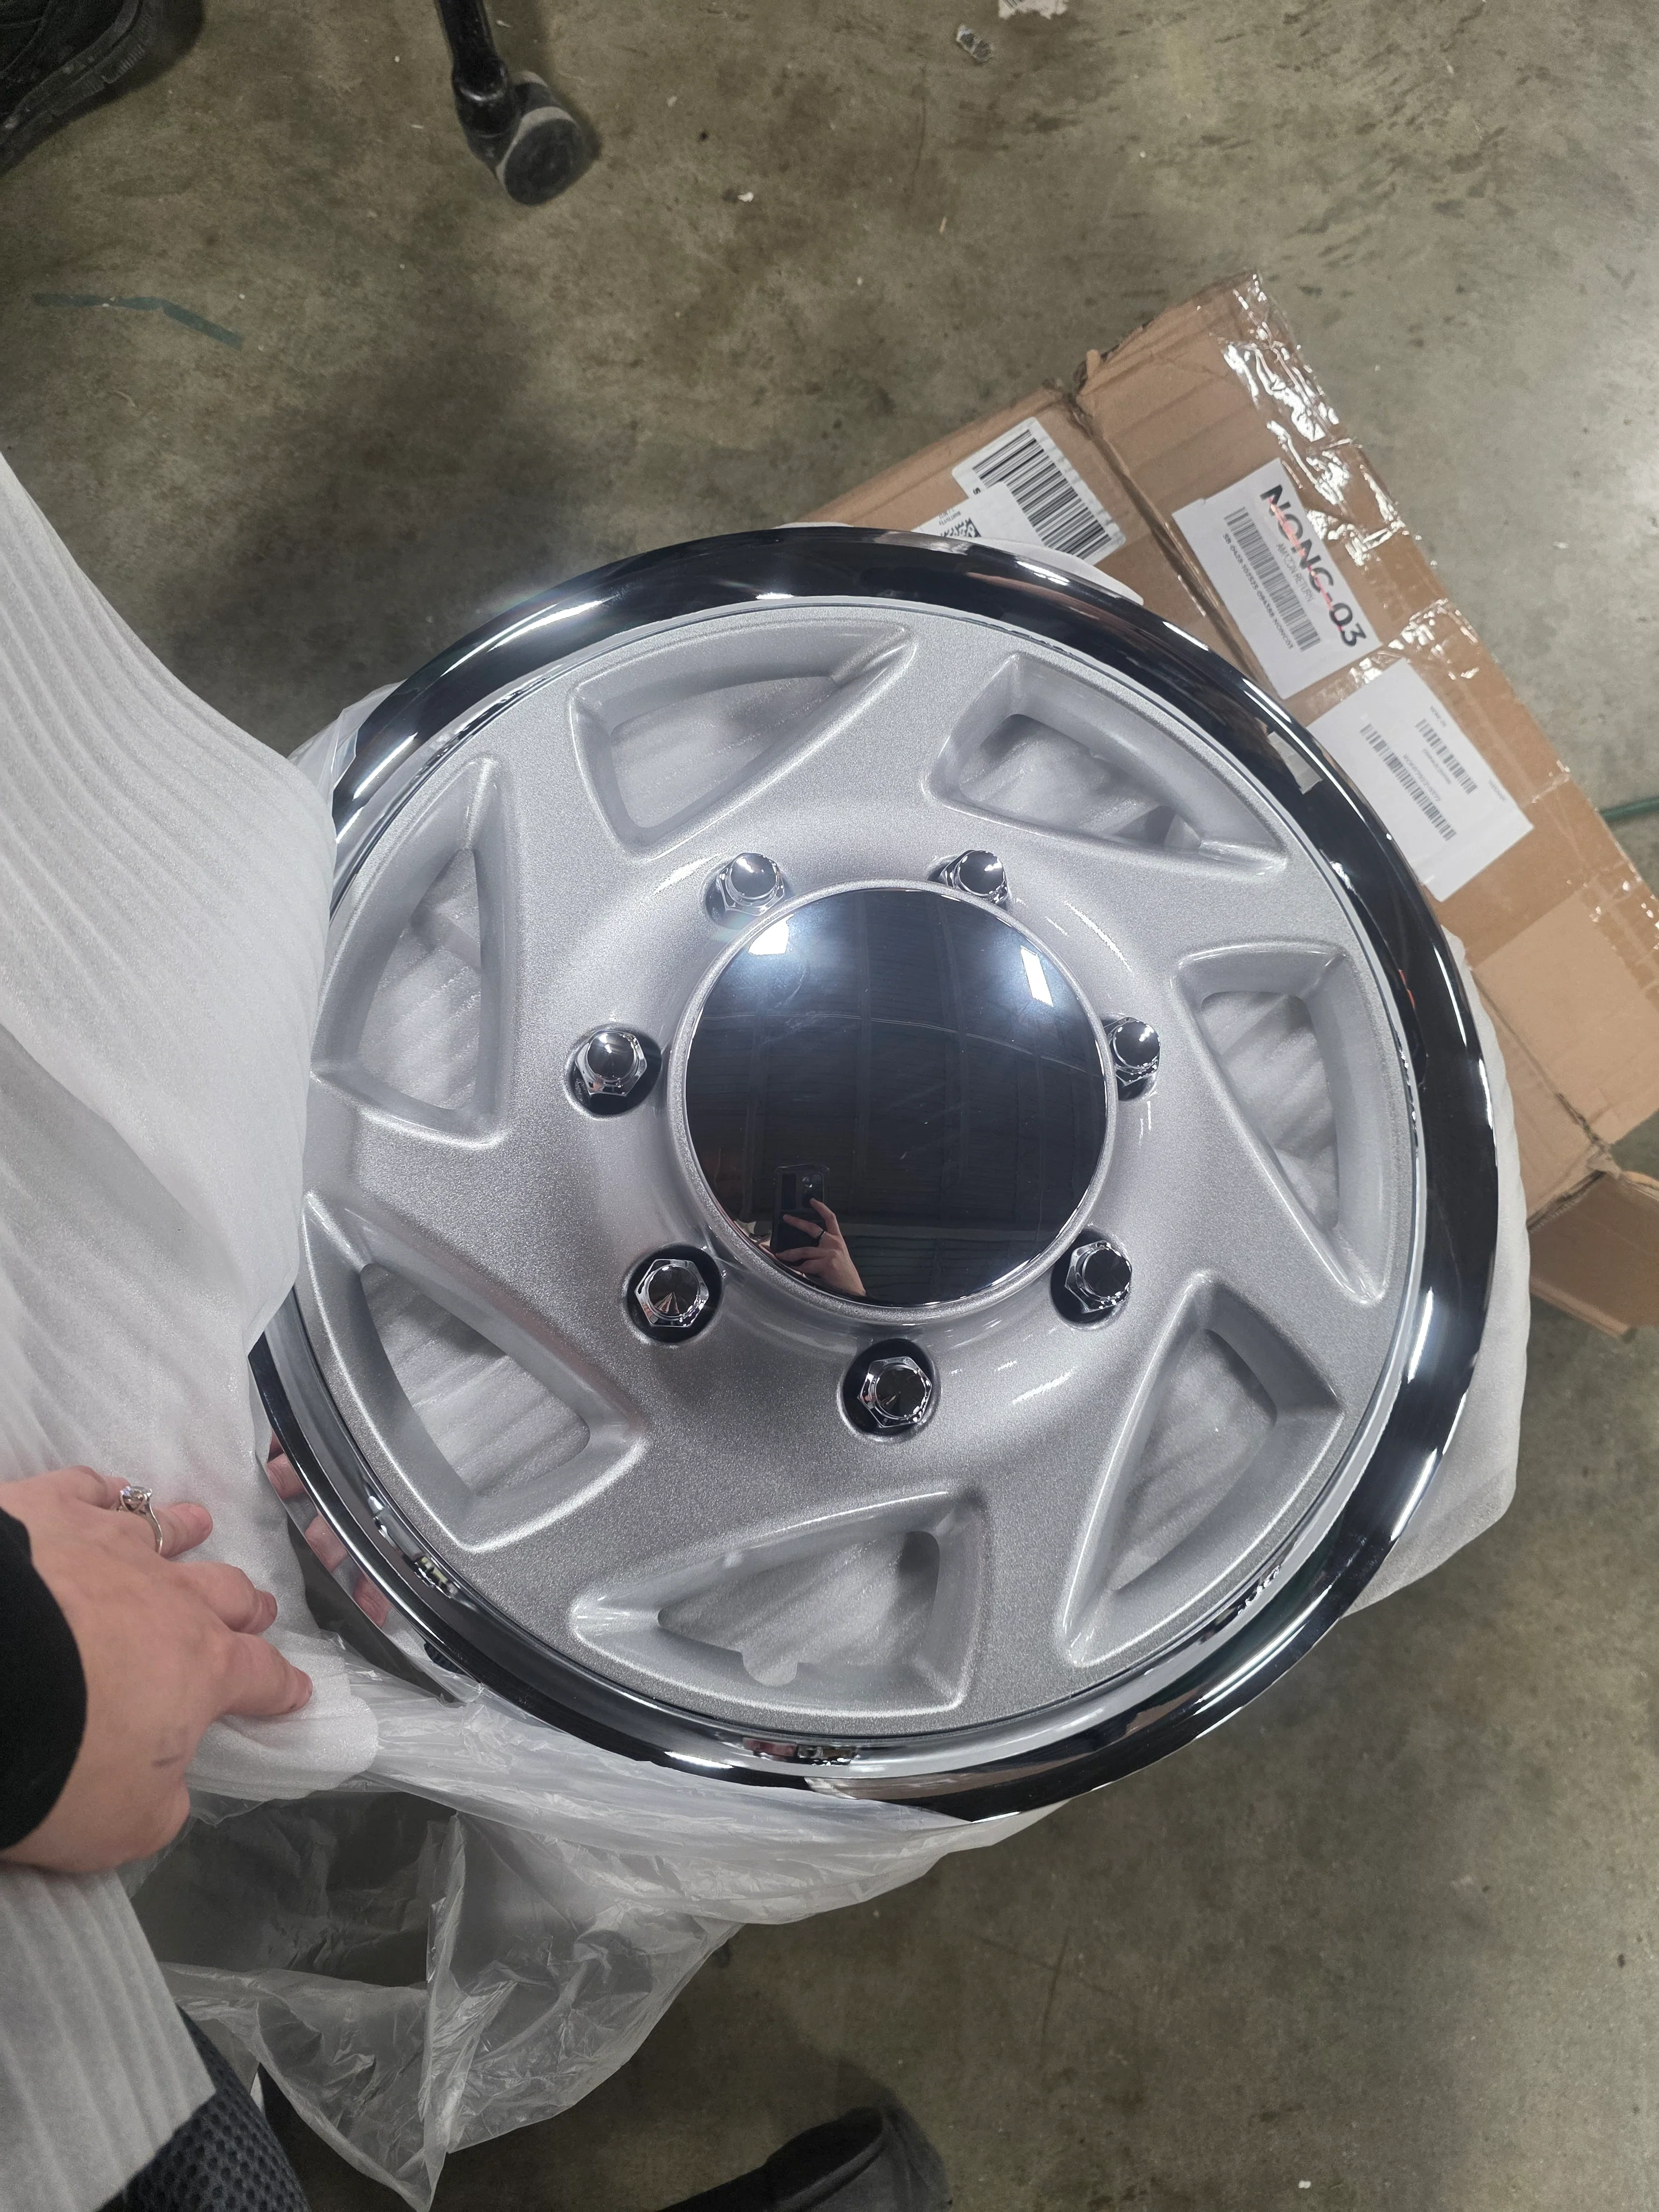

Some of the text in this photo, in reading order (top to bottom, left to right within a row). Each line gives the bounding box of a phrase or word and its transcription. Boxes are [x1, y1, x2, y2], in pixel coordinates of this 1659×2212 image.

[1260, 484, 1367, 647] NONC-03
[1276, 542, 1315, 603] AMAZON RETURN
